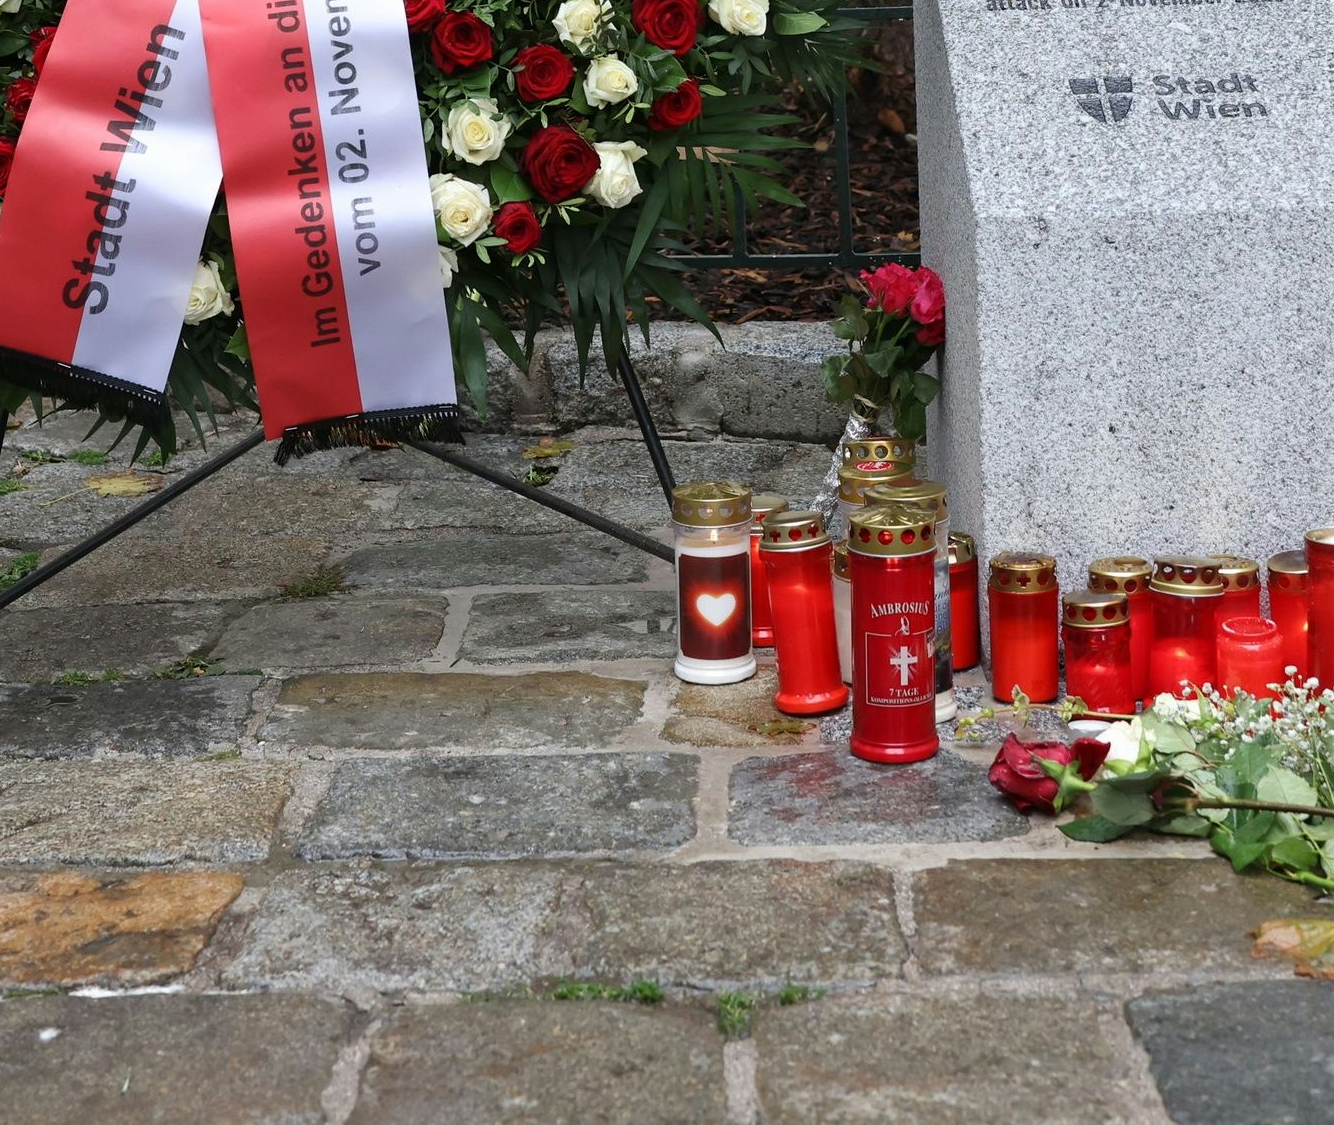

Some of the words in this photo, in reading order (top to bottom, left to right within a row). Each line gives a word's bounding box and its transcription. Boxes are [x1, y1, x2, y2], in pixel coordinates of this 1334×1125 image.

[280, 47, 309, 93] an
[1152, 73, 1260, 95] Stadt
[1157, 98, 1268, 120] Wien
[62, 171, 136, 315] Stadt
[99, 23, 185, 154] Wien
[335, 128, 369, 183] 02.
[287, 106, 334, 297] Gedenken
[351, 196, 381, 276] vom
[311, 307, 341, 347] Im
[870, 600, 930, 619] AMBROSIUS
[889, 688, 895, 697] 7
[896, 687, 920, 697] TAGE
